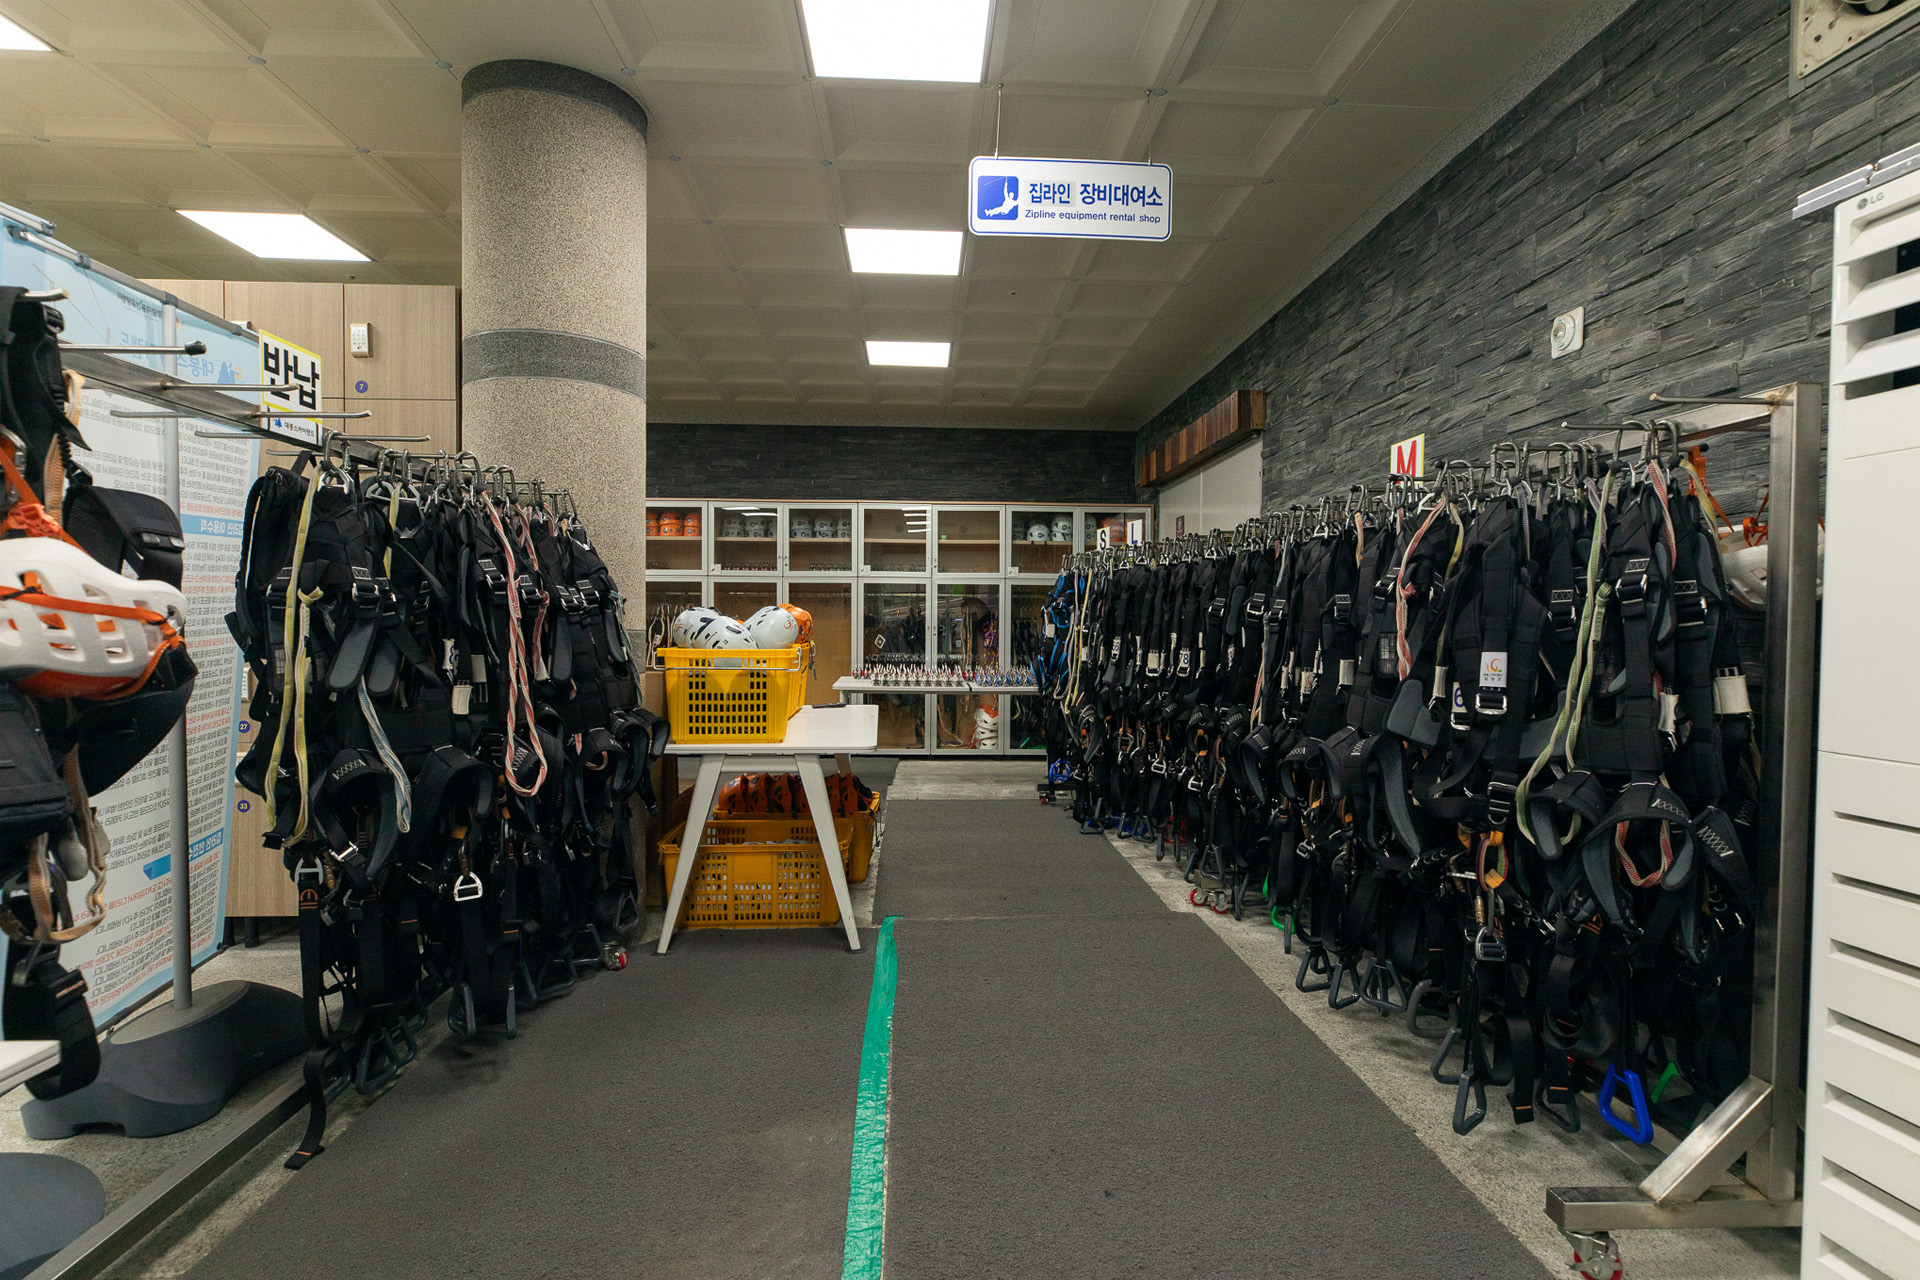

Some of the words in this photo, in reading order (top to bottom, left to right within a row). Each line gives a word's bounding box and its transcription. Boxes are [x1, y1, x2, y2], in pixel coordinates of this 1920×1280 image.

[1029, 183, 1071, 204] 집라인
[1080, 183, 1163, 208] 장비대여소
[1870, 192, 1884, 204] LG
[1025, 210, 1056, 219] Zipline
[1059, 212, 1106, 220] equipment
[1110, 213, 1135, 222] rental
[1139, 214, 1161, 224] shop
[264, 342, 320, 410] 반납
[1396, 440, 1416, 484] M
[1100, 530, 1106, 550] S
[1132, 522, 1138, 544] L
